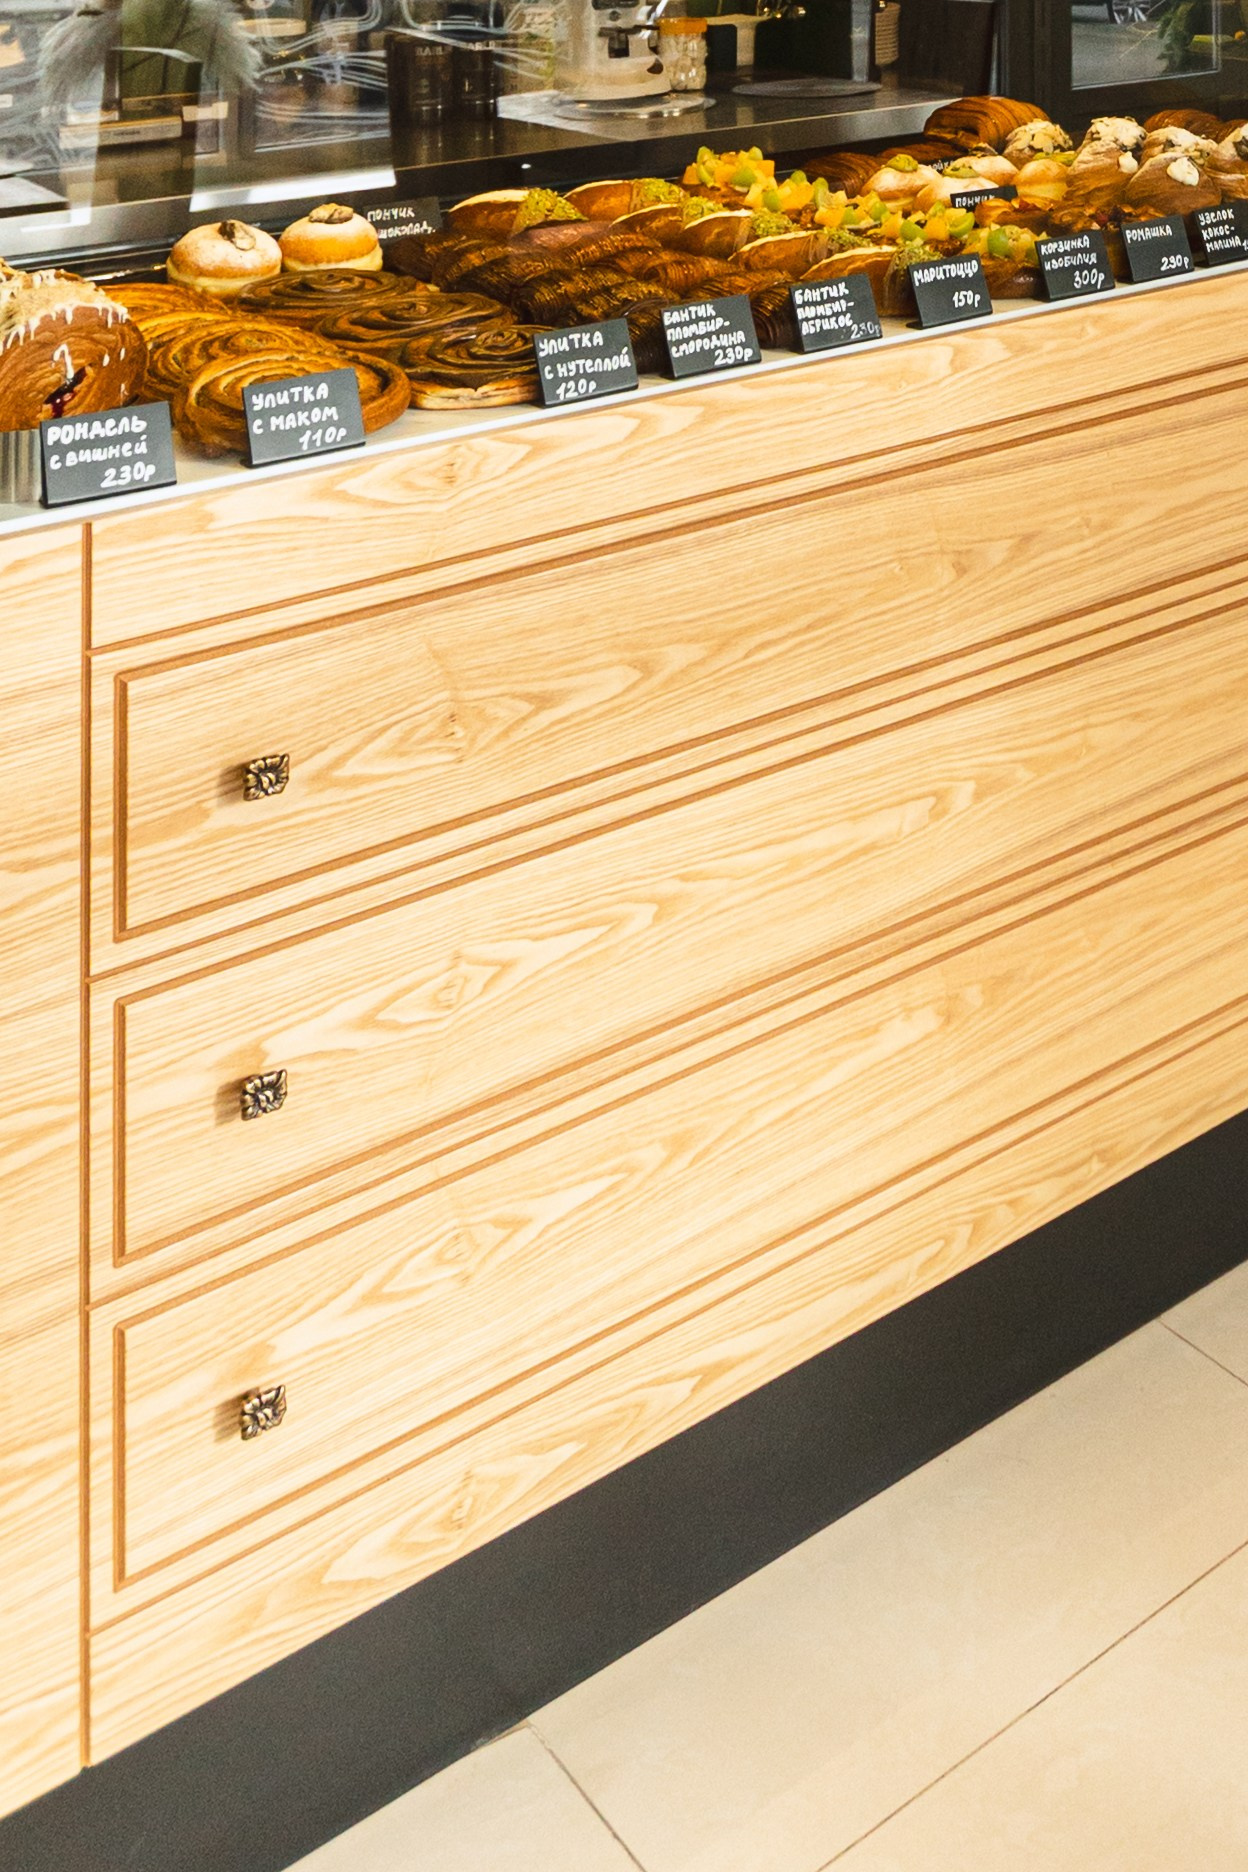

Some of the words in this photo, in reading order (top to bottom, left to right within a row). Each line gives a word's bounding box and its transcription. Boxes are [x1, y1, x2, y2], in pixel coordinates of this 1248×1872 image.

[367, 207, 416, 222] ПОНЧИК
[1198, 208, 1235, 226] УЗЕЛОК
[1125, 224, 1173, 244] РОМАШКА
[1201, 224, 1235, 241] КОКОС-
[1205, 235, 1242, 253] МАЛИНА
[1040, 234, 1090, 256] КОРЗИНКА
[913, 259, 979, 287] МАРИТОЦЦО
[1044, 252, 1098, 271] ИЗОБИЛИЯ
[1073, 268, 1105, 290] 300р
[794, 281, 850, 305] БАНТИК
[952, 289, 981, 308] 150р
[663, 303, 716, 326] БАНТИК
[801, 312, 853, 336] АБРИКОС
[538, 330, 604, 358] УЛИТКА
[671, 330, 746, 358] СМОРОДИНА
[714, 345, 754, 367] 230р
[252, 382, 329, 411] УЛИТКА
[555, 378, 597, 401] 120р
[270, 406, 339, 431] МАКОМ
[47, 415, 148, 446] РОНДЕЛЬ
[299, 426, 347, 451] 110р
[65, 434, 148, 467] ВИШНЕЙ
[100, 461, 156, 488] 230р
